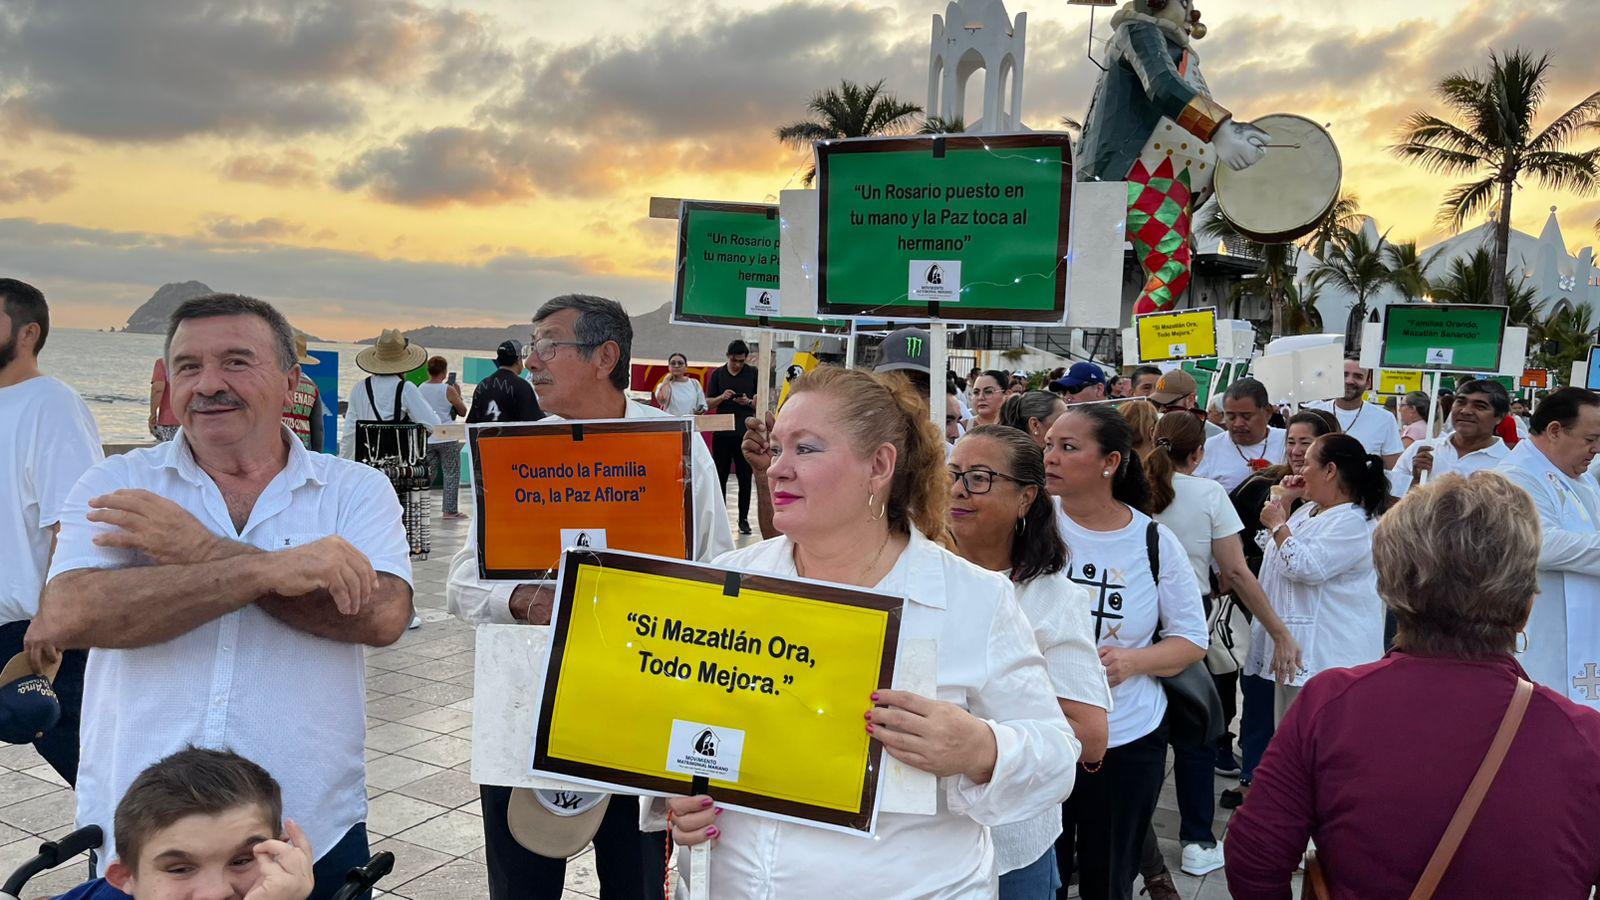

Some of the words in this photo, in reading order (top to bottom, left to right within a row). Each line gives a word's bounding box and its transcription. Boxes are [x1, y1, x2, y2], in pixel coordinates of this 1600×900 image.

[854, 183, 881, 200] “Un
[885, 183, 941, 200] Rosario
[945, 182, 1000, 202] puesto
[1004, 185, 1024, 198] en
[850, 210, 864, 226] tu
[867, 212, 908, 226] mano
[911, 212, 920, 229] y
[923, 209, 936, 225] la
[940, 209, 969, 225] Paz
[972, 210, 1008, 225] toca
[1012, 208, 1027, 225] al
[706, 232, 728, 245] “Un
[730, 233, 772, 248] Rosario
[897, 234, 972, 251] hermano”
[703, 249, 715, 261] tu
[717, 252, 747, 264] mano
[749, 255, 756, 266] y
[757, 252, 767, 265] la
[738, 269, 780, 283] herman
[511, 463, 574, 479] “Cuando
[577, 462, 590, 478] la
[594, 461, 647, 478] Familia
[514, 487, 546, 505] Ora,
[549, 487, 562, 503] la
[565, 487, 591, 503] Paz
[594, 486, 647, 503] Aflora”
[627, 612, 658, 638] “Si
[662, 618, 762, 656] Mazatlán
[767, 635, 816, 669] Ora,
[638, 650, 692, 680] Todo
[697, 660, 794, 696] Mejora.”
